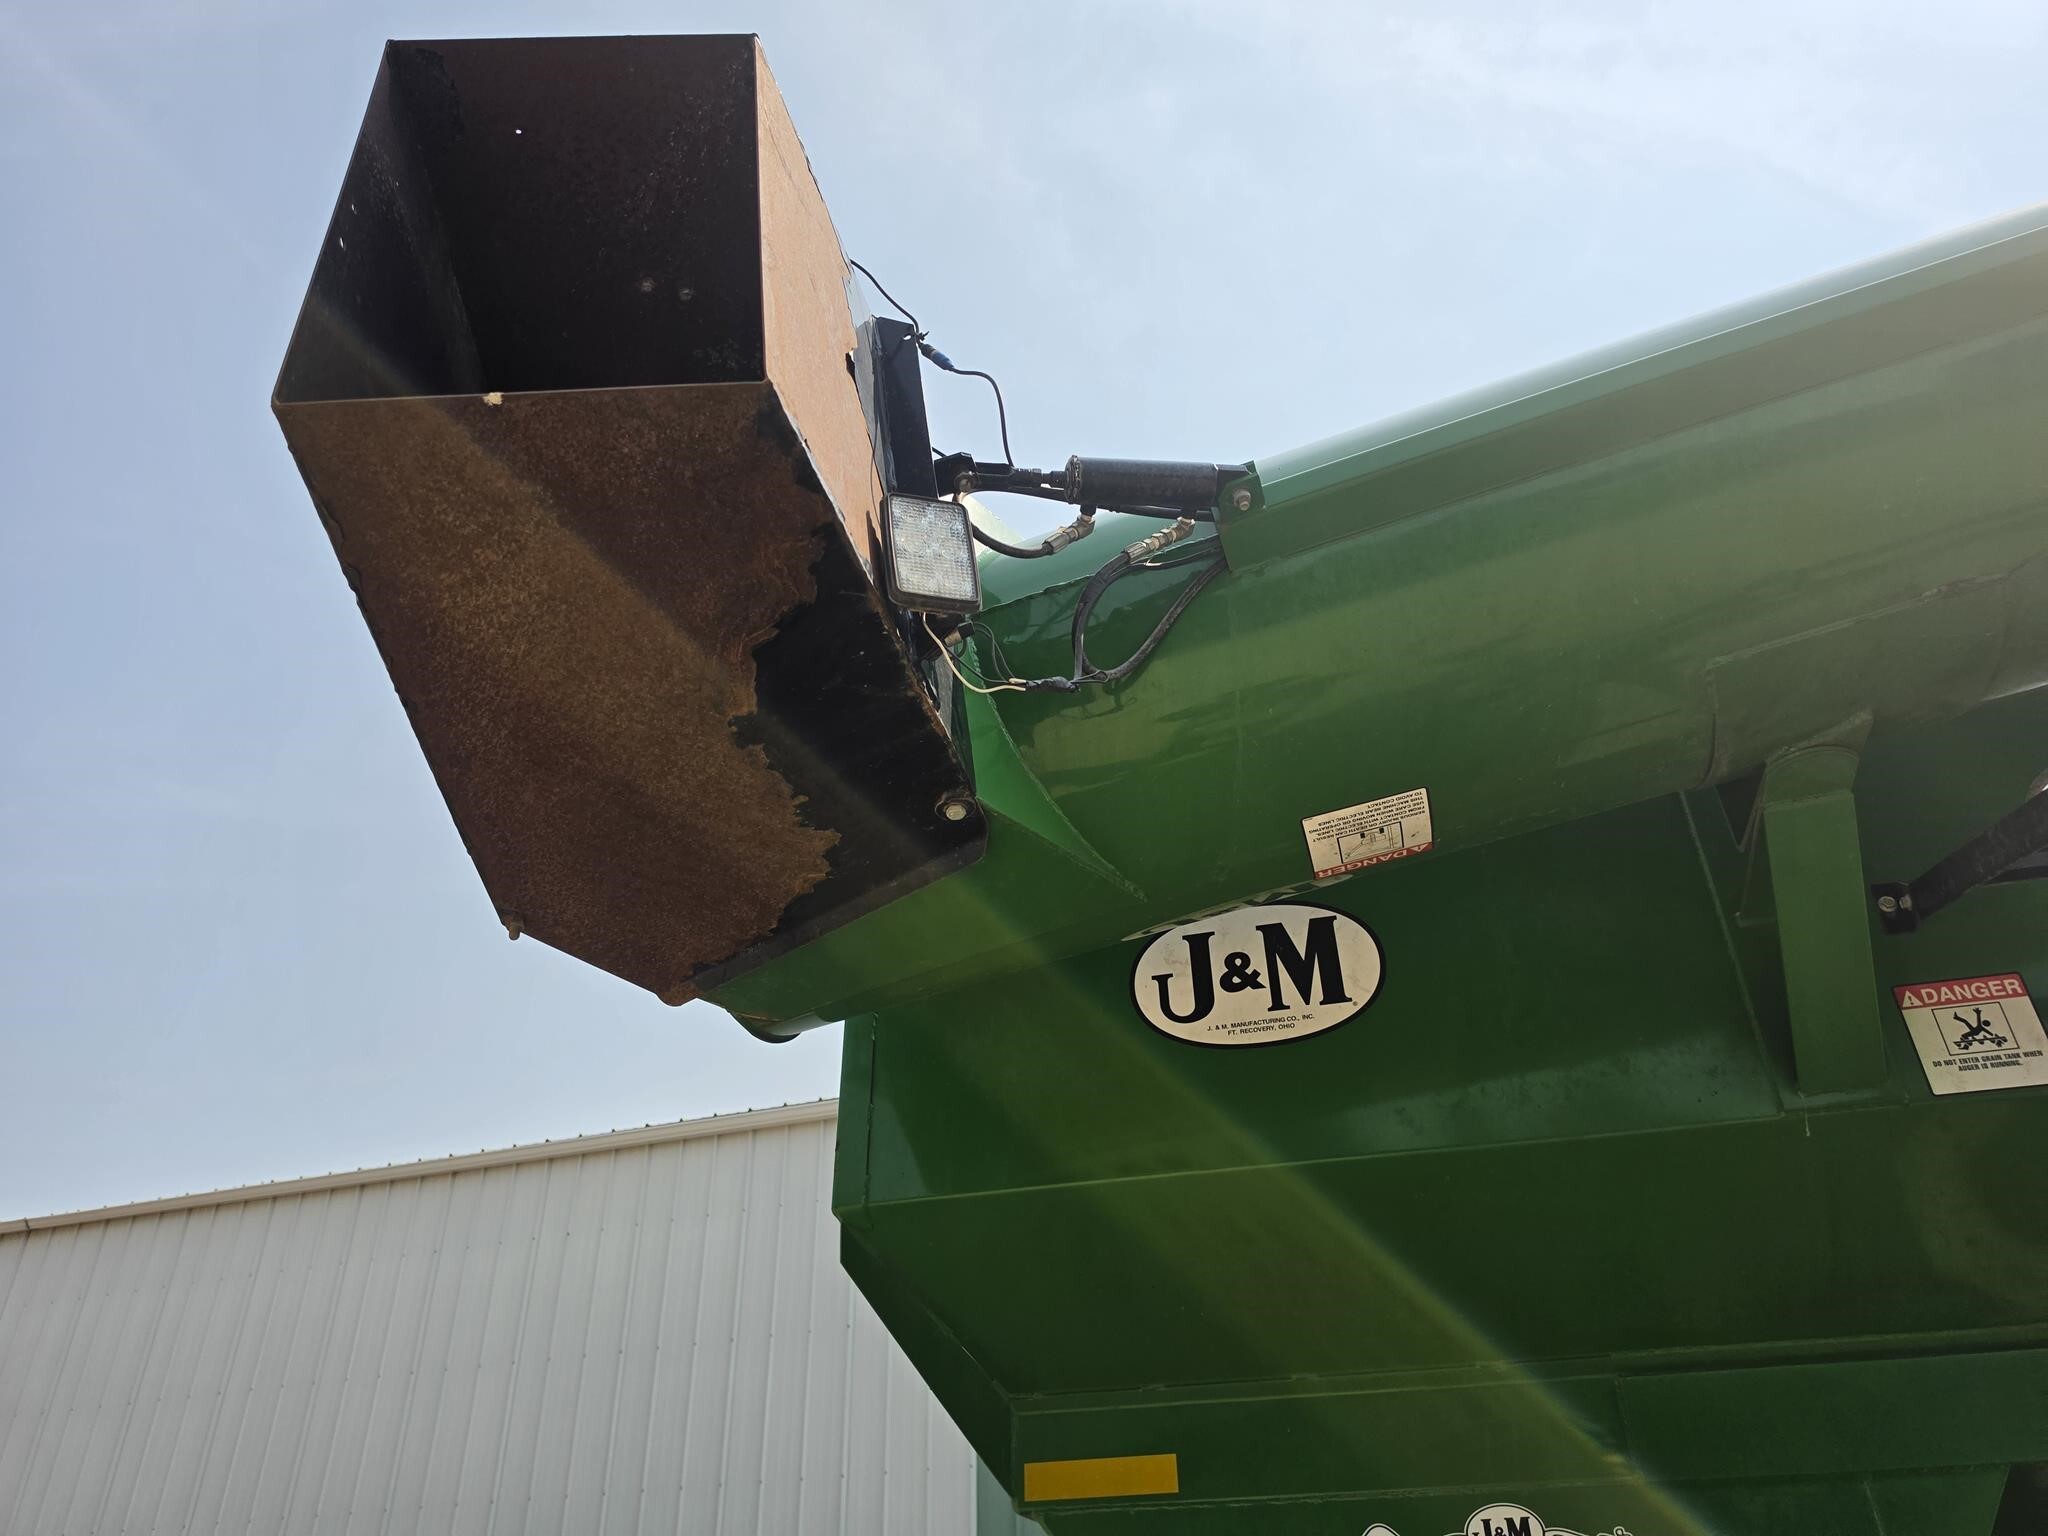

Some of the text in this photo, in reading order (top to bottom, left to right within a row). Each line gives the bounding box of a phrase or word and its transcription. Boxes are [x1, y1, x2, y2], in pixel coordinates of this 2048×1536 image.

[1396, 793, 1414, 801] AVOID
[1383, 799, 1409, 810] MACHINE
[1395, 804, 1412, 812] CARE
[1407, 805, 1425, 814] FROM
[1336, 810, 1364, 822] ELECTRIC
[1352, 813, 1375, 823] MOVING
[1376, 809, 1394, 817] WHEN
[1380, 810, 1407, 821] CONTACT
[1400, 810, 1425, 822] SERIOUS
[1379, 816, 1399, 825] INJURY
[1308, 822, 1341, 834] OPERATING
[1335, 822, 1363, 832] ELECTRIC
[1348, 825, 1368, 833] DEATH
[1312, 834, 1334, 842] RESULT
[1318, 850, 1407, 878] DANGER
[1152, 915, 1352, 1024] J&M
[1920, 979, 2023, 1004] DANGER
[1231, 1017, 1285, 1028] MANUFACTURING
[1240, 1025, 1276, 1034] RECOVERY,
[1958, 1063, 1980, 1071] AUGER
[1989, 1060, 2024, 1068] RUNNING.
[1472, 1516, 1531, 1536] J&M
